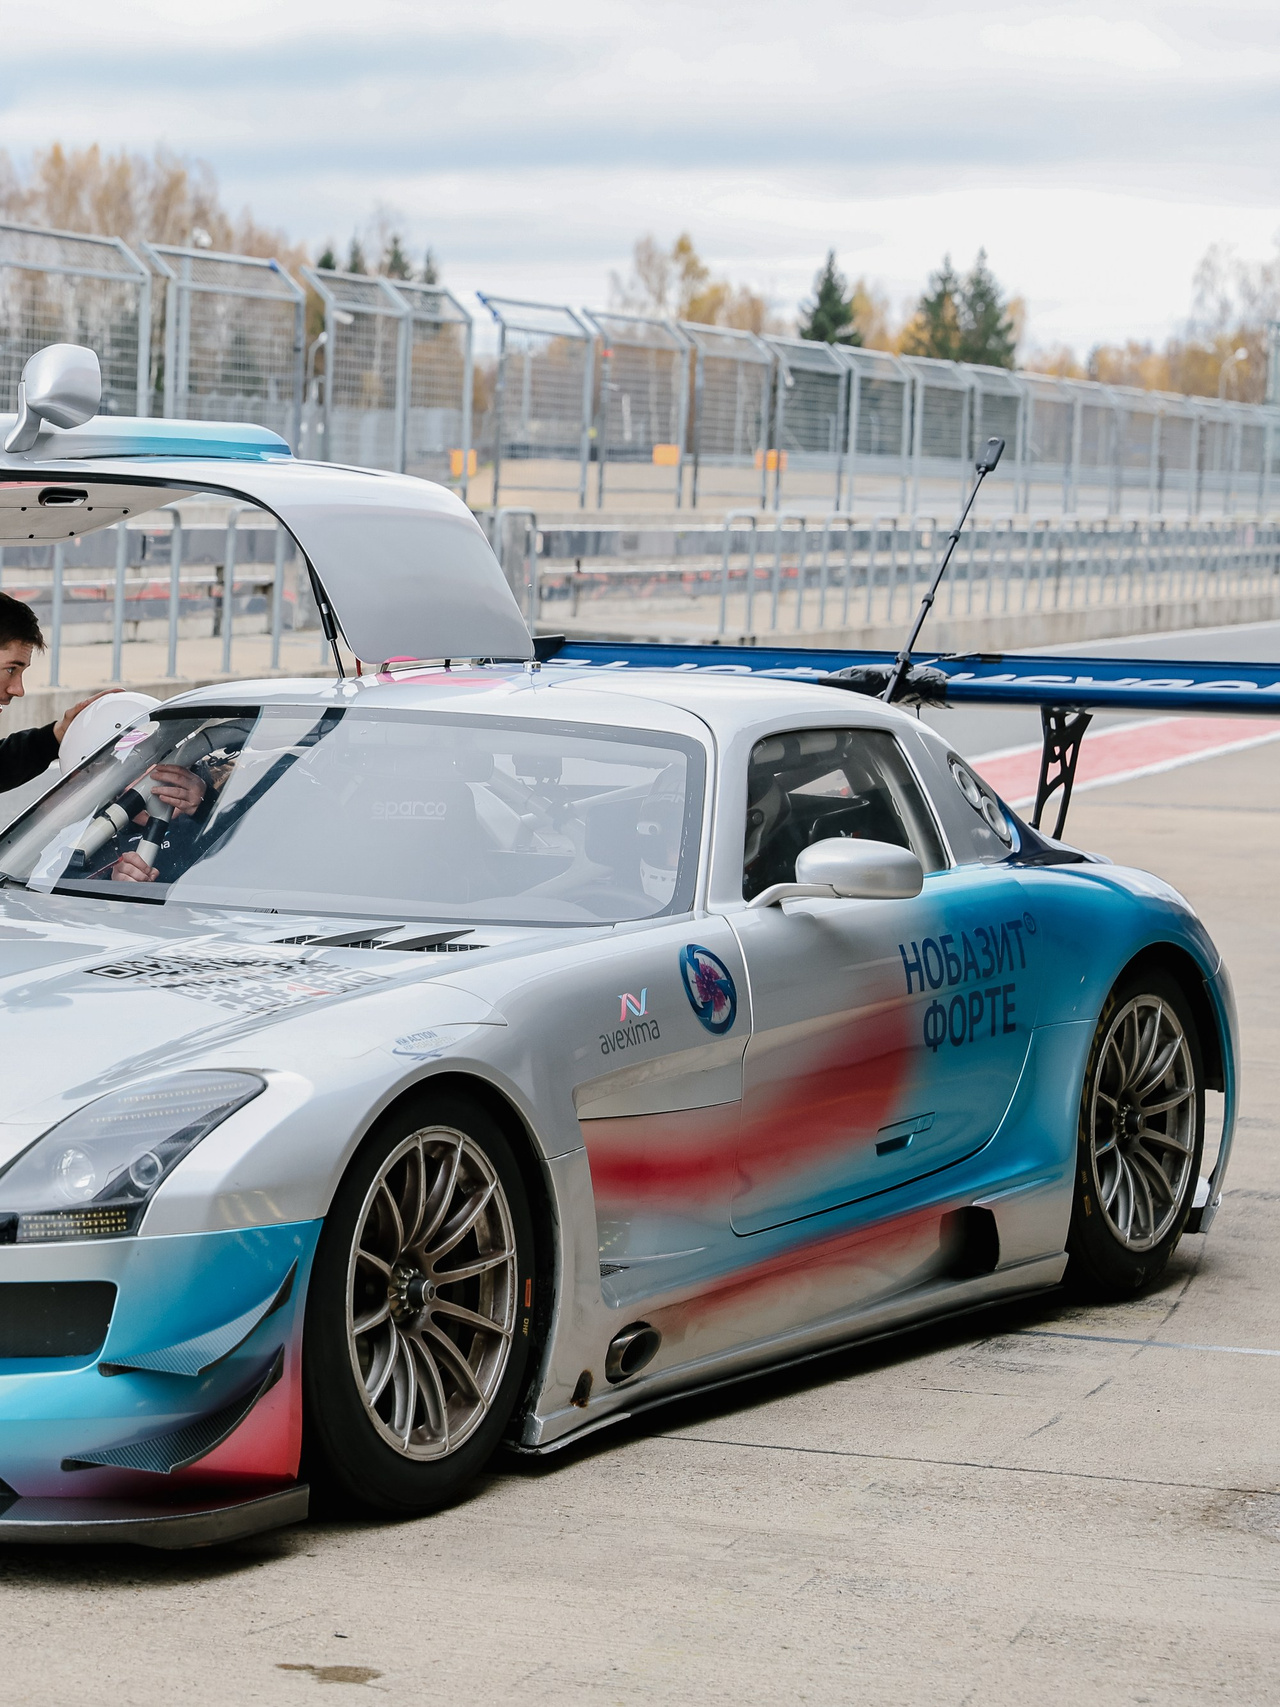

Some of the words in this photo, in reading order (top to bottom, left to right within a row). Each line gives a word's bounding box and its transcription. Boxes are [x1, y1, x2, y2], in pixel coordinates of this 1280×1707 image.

[371, 801, 447, 820] sparco
[923, 983, 1016, 1053] ФОРТЕ
[407, 1029, 439, 1043] ACTION
[599, 1019, 661, 1055] avexima
